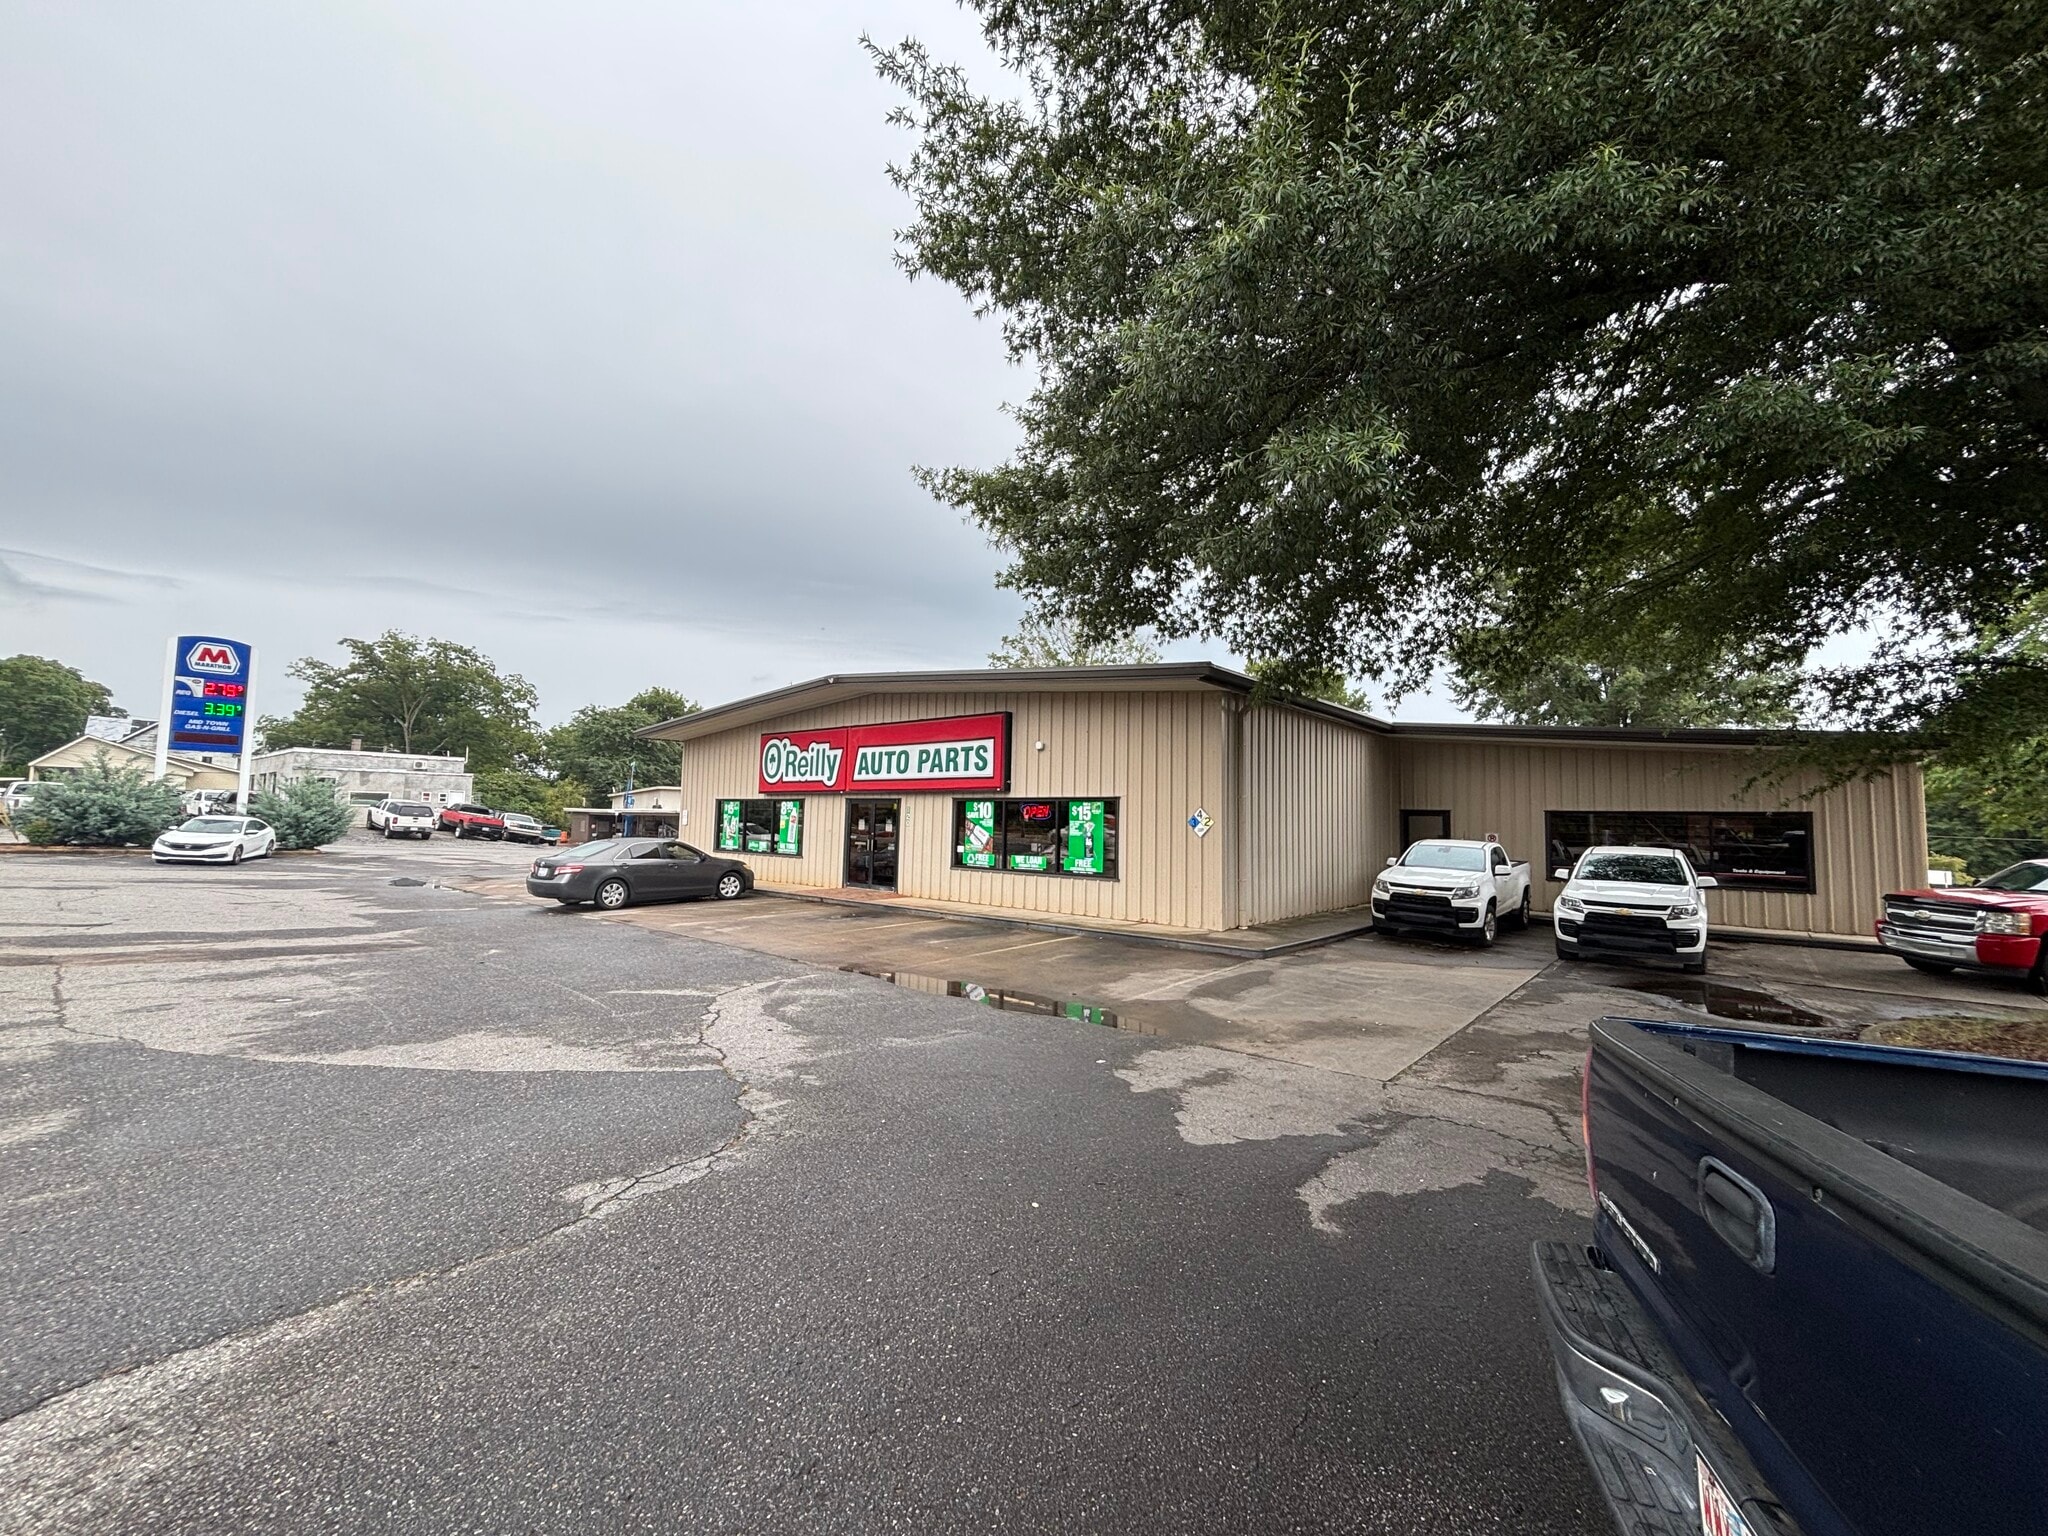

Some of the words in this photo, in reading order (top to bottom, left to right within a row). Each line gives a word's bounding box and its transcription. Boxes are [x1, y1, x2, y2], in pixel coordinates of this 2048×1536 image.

[194, 662, 232, 670] MARATHON
[174, 709, 200, 717] DIESEL
[184, 724, 231, 732] GAS-N-GRILL
[763, 741, 838, 781] O'Reilly
[857, 749, 910, 775] AUTO
[917, 744, 989, 773] PARTS
[973, 801, 992, 818] $10
[1023, 805, 1050, 819] OPEN
[1071, 805, 1091, 821] $15
[1204, 817, 1210, 827] 2
[975, 853, 989, 862] FREE
[1074, 859, 1092, 867] FREE
